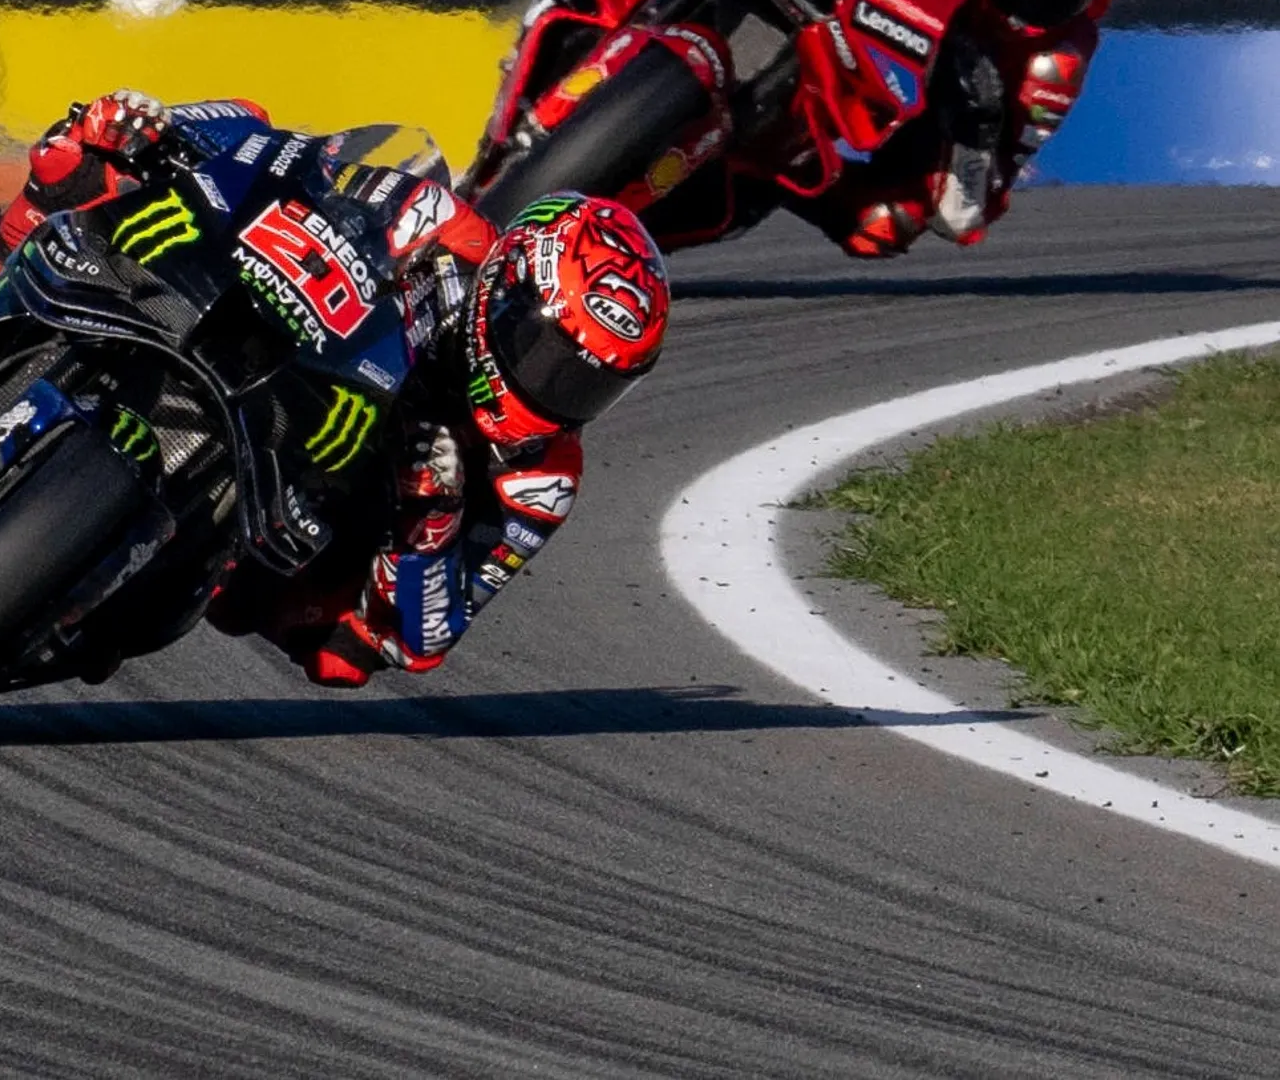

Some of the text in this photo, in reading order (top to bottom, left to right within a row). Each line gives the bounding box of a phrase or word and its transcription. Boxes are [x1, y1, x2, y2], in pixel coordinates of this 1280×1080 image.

[857, 1, 931, 56] Lenovo
[270, 137, 308, 177] Roboze
[47, 241, 100, 275] REEJO
[239, 199, 376, 339] 20
[302, 213, 377, 300] ENEOS
[240, 271, 310, 342] ENERGY
[591, 299, 641, 336] HJC
[286, 484, 320, 535] REEJO
[423, 557, 452, 657] YAMAHA
